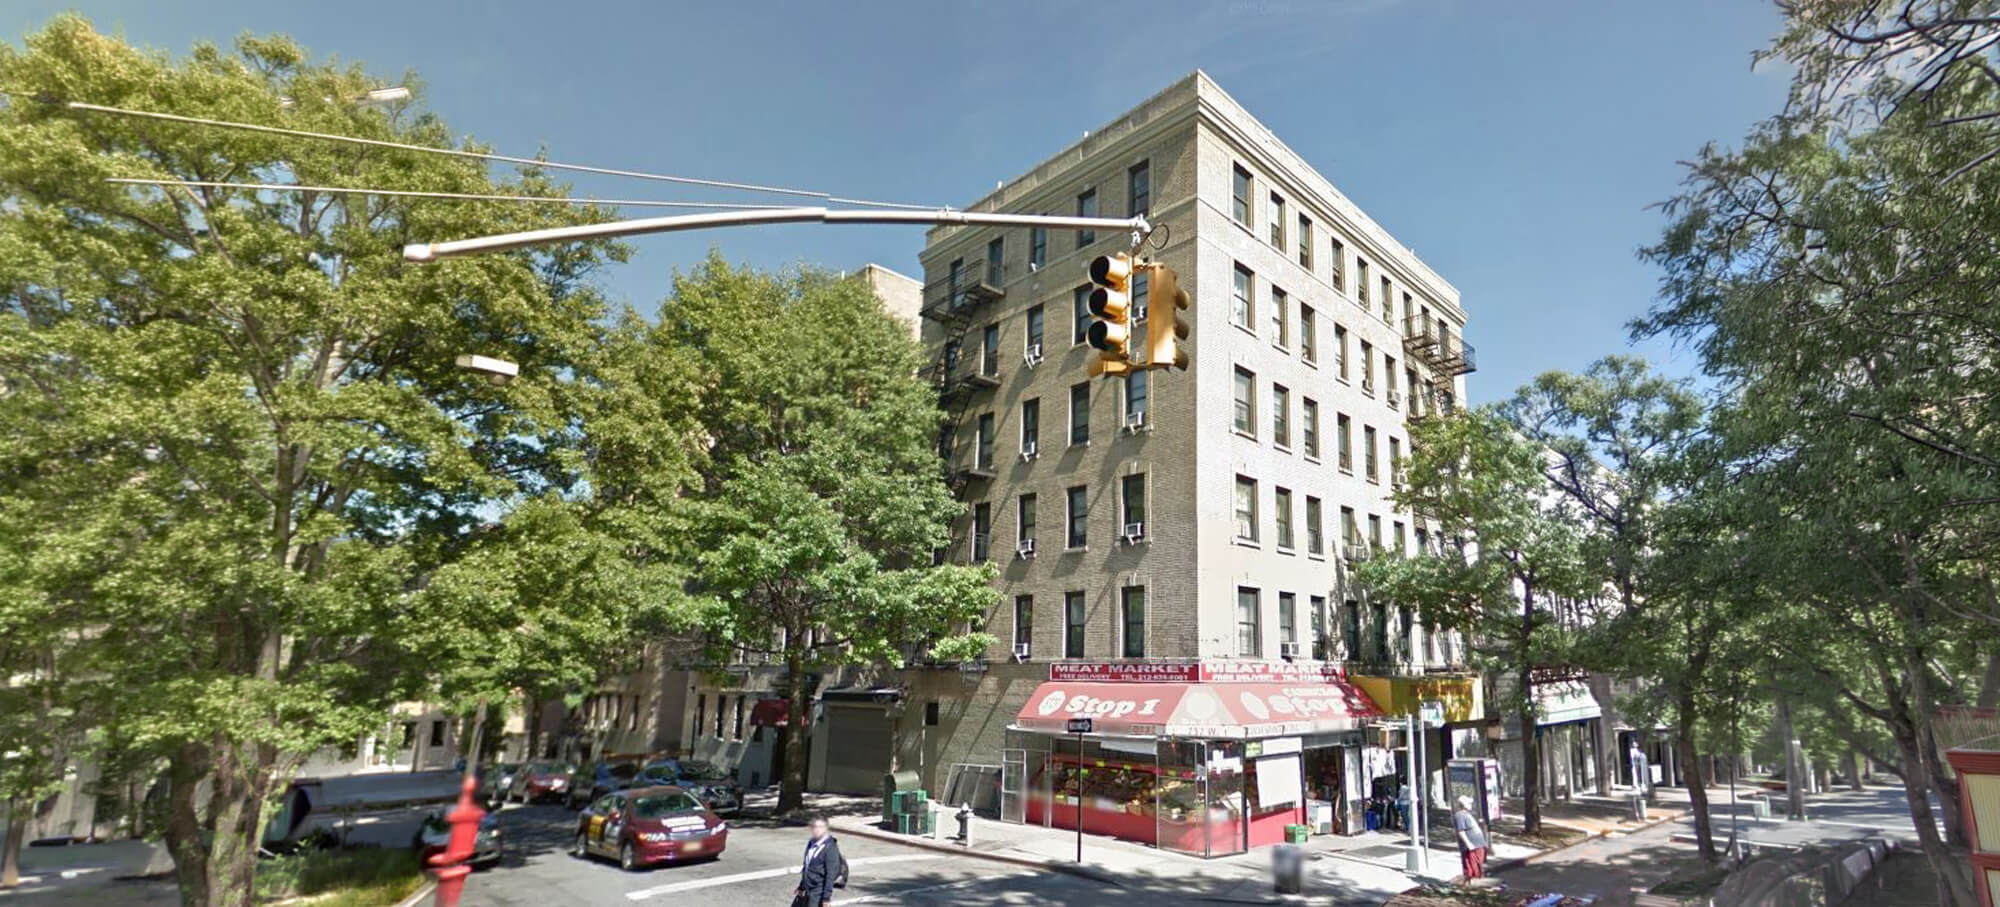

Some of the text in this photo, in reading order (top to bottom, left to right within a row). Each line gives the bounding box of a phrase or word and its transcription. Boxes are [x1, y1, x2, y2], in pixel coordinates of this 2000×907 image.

[1055, 664, 1193, 673] MEAT MARKET
[1205, 663, 1265, 673] MEAT
[1065, 695, 1136, 718] Stop
